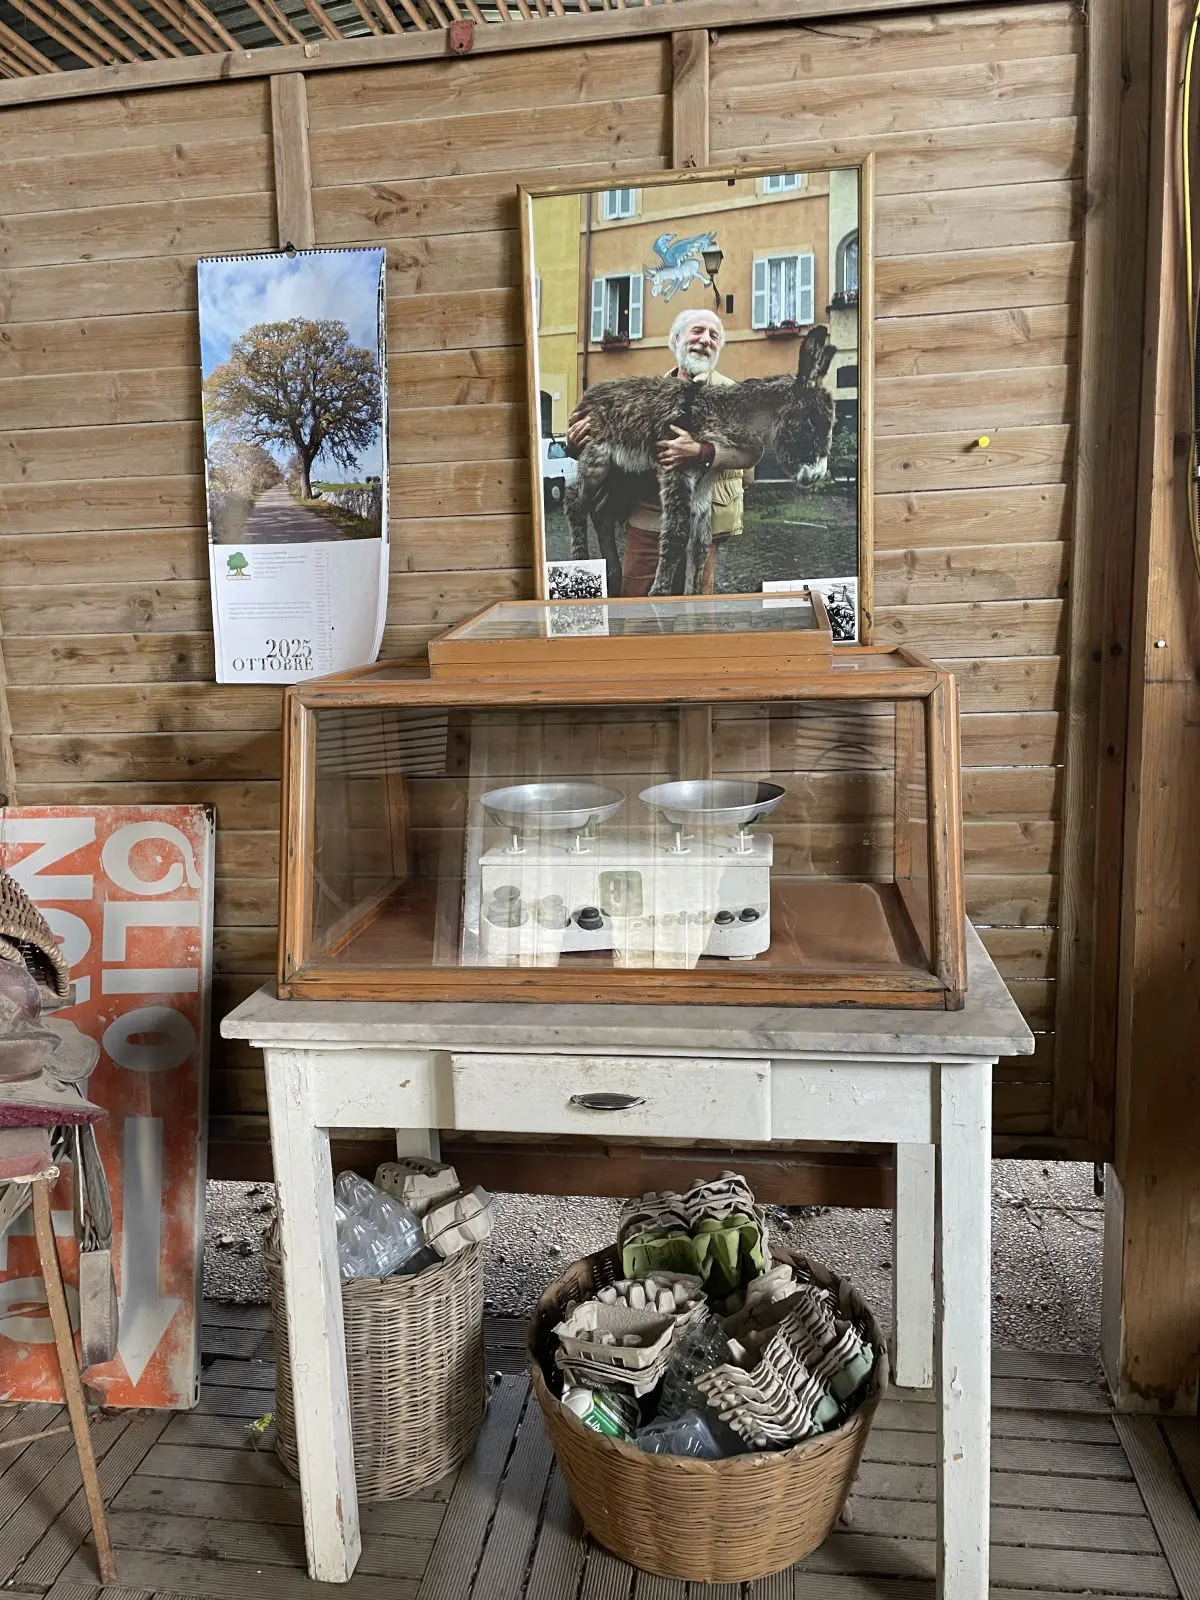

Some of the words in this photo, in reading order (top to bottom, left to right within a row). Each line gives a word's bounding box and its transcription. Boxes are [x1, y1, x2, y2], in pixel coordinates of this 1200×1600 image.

[266, 638, 312, 658] 2025
[232, 656, 314, 671] OTTOBRE
[101, 820, 201, 1072] OLIO
